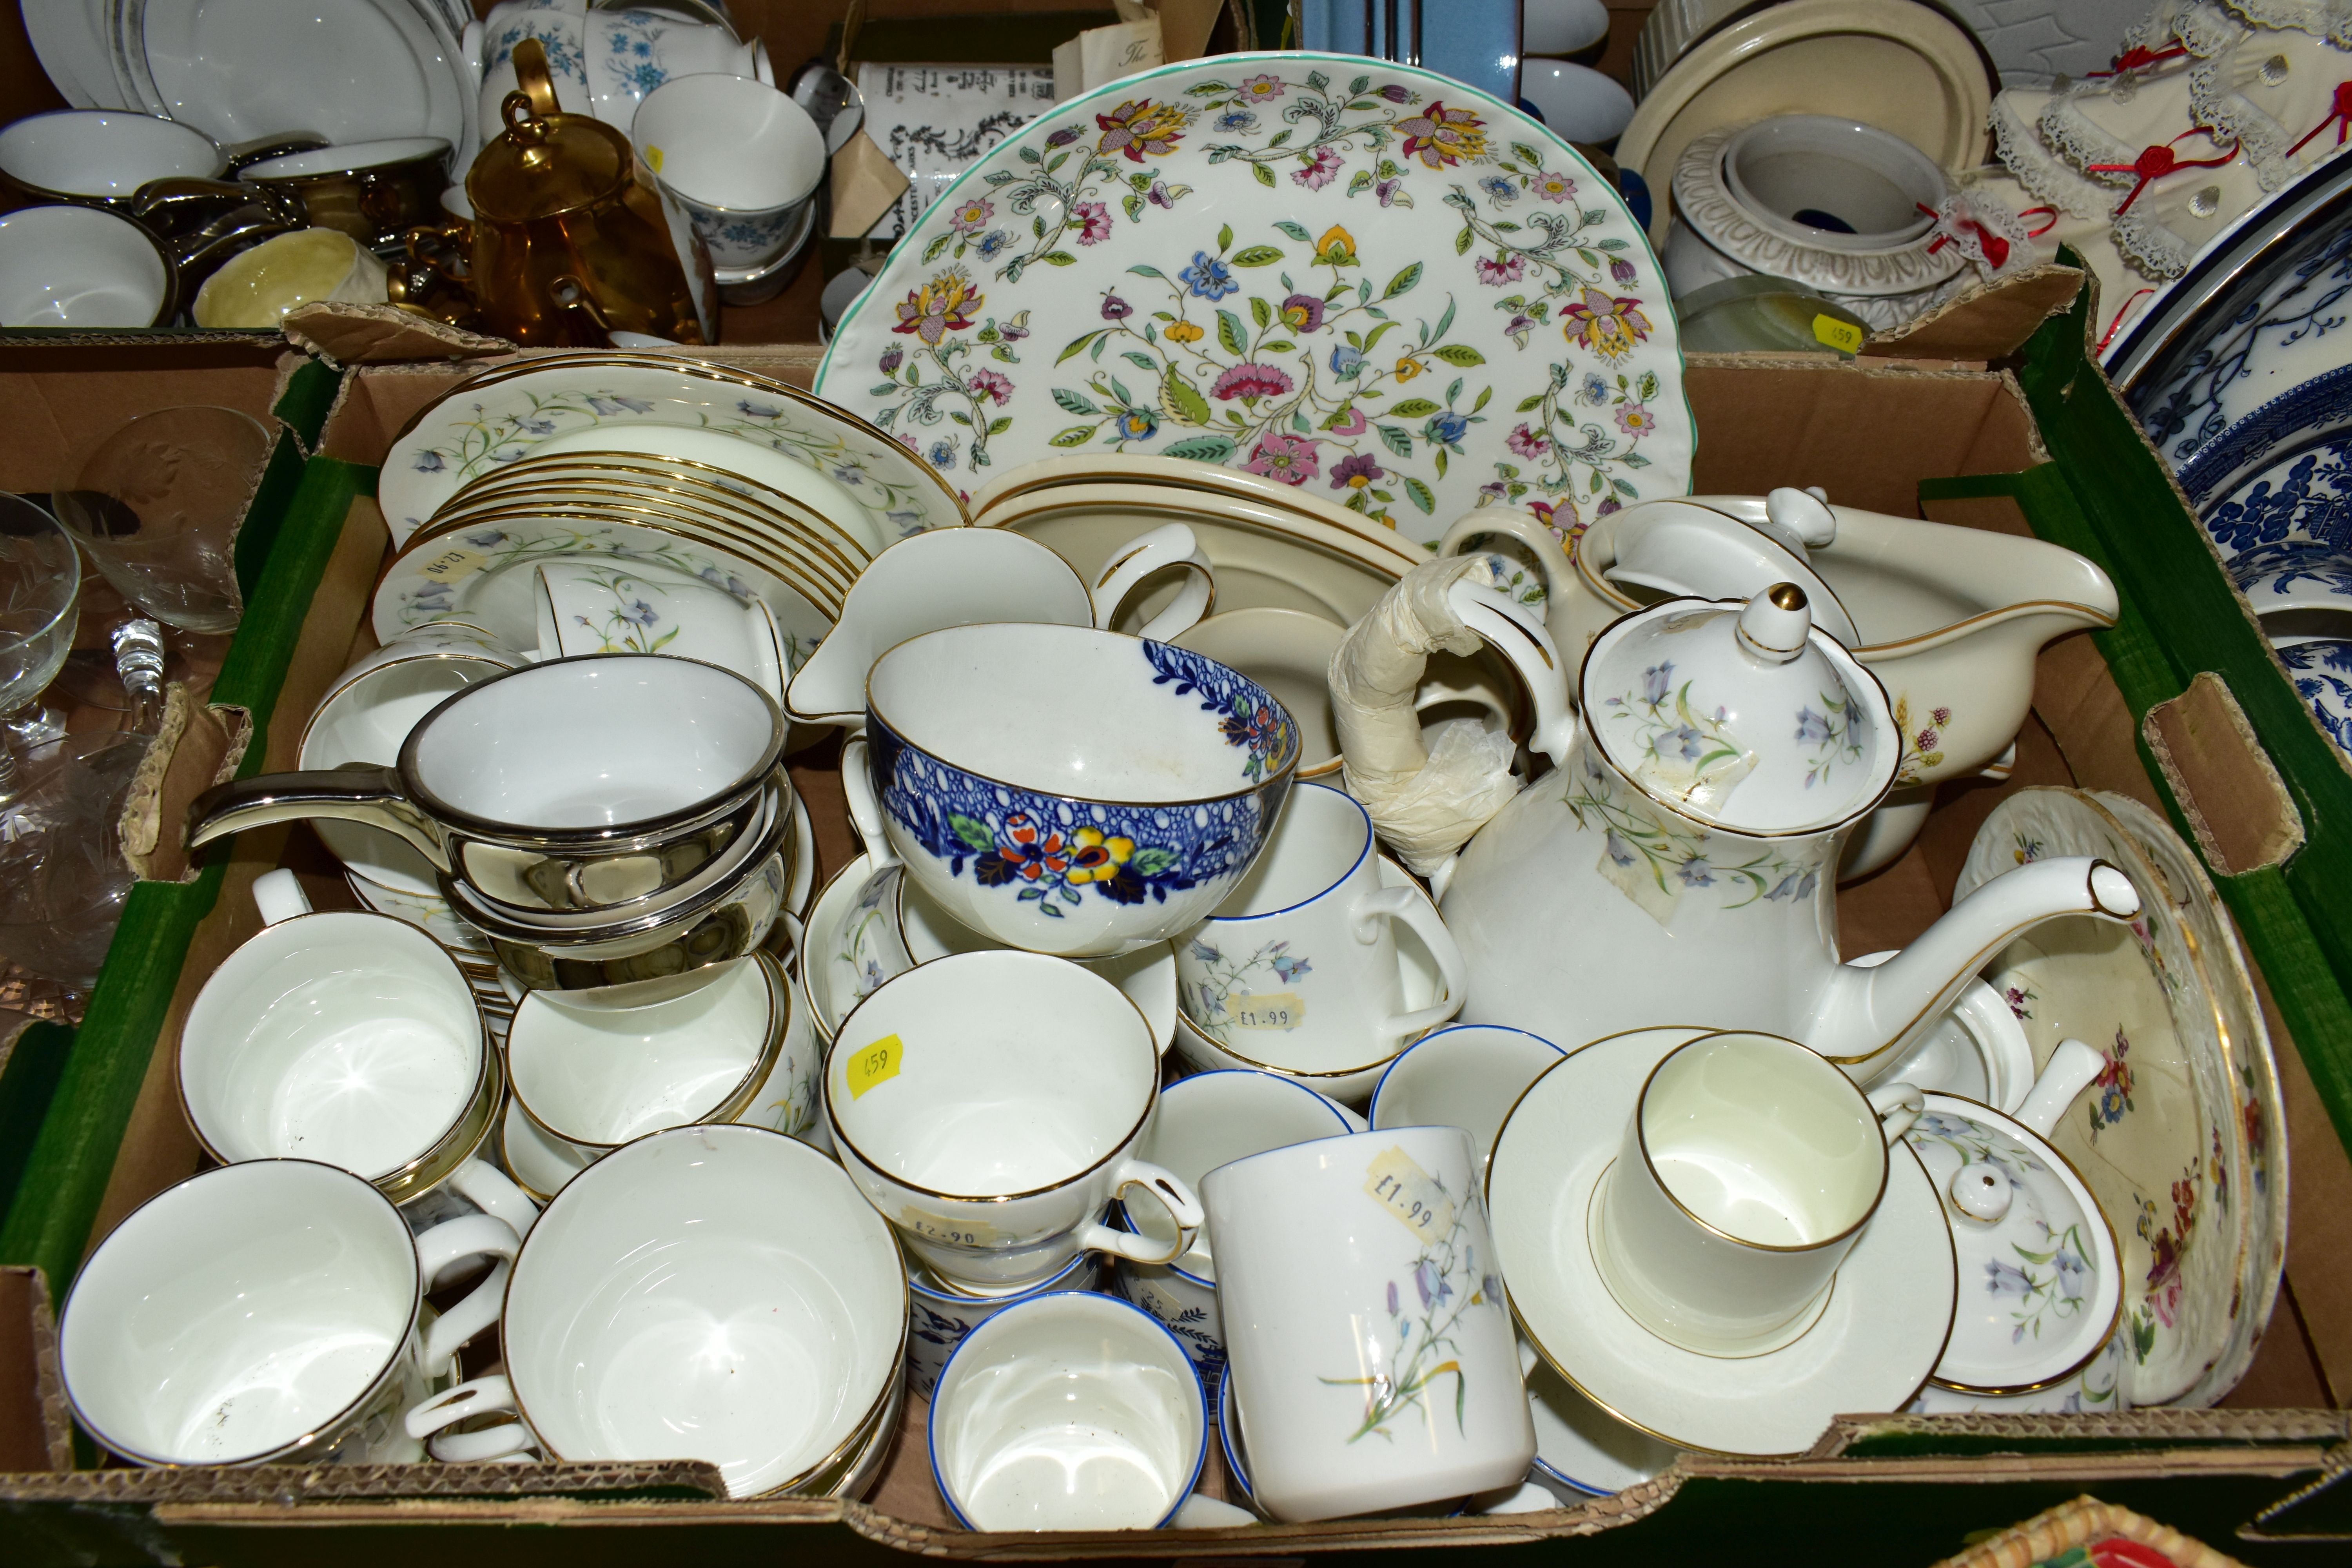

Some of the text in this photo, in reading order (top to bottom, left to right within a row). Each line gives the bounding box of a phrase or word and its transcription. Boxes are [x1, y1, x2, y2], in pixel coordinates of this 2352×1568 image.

[908, 145, 917, 178] ARKS
[427, 552, 465, 573] £2.90
[1241, 1011, 1288, 1025] £1.99
[864, 1049, 887, 1077] 459
[1374, 1174, 1432, 1228] £1.99
[915, 1221, 975, 1244] £2.90
